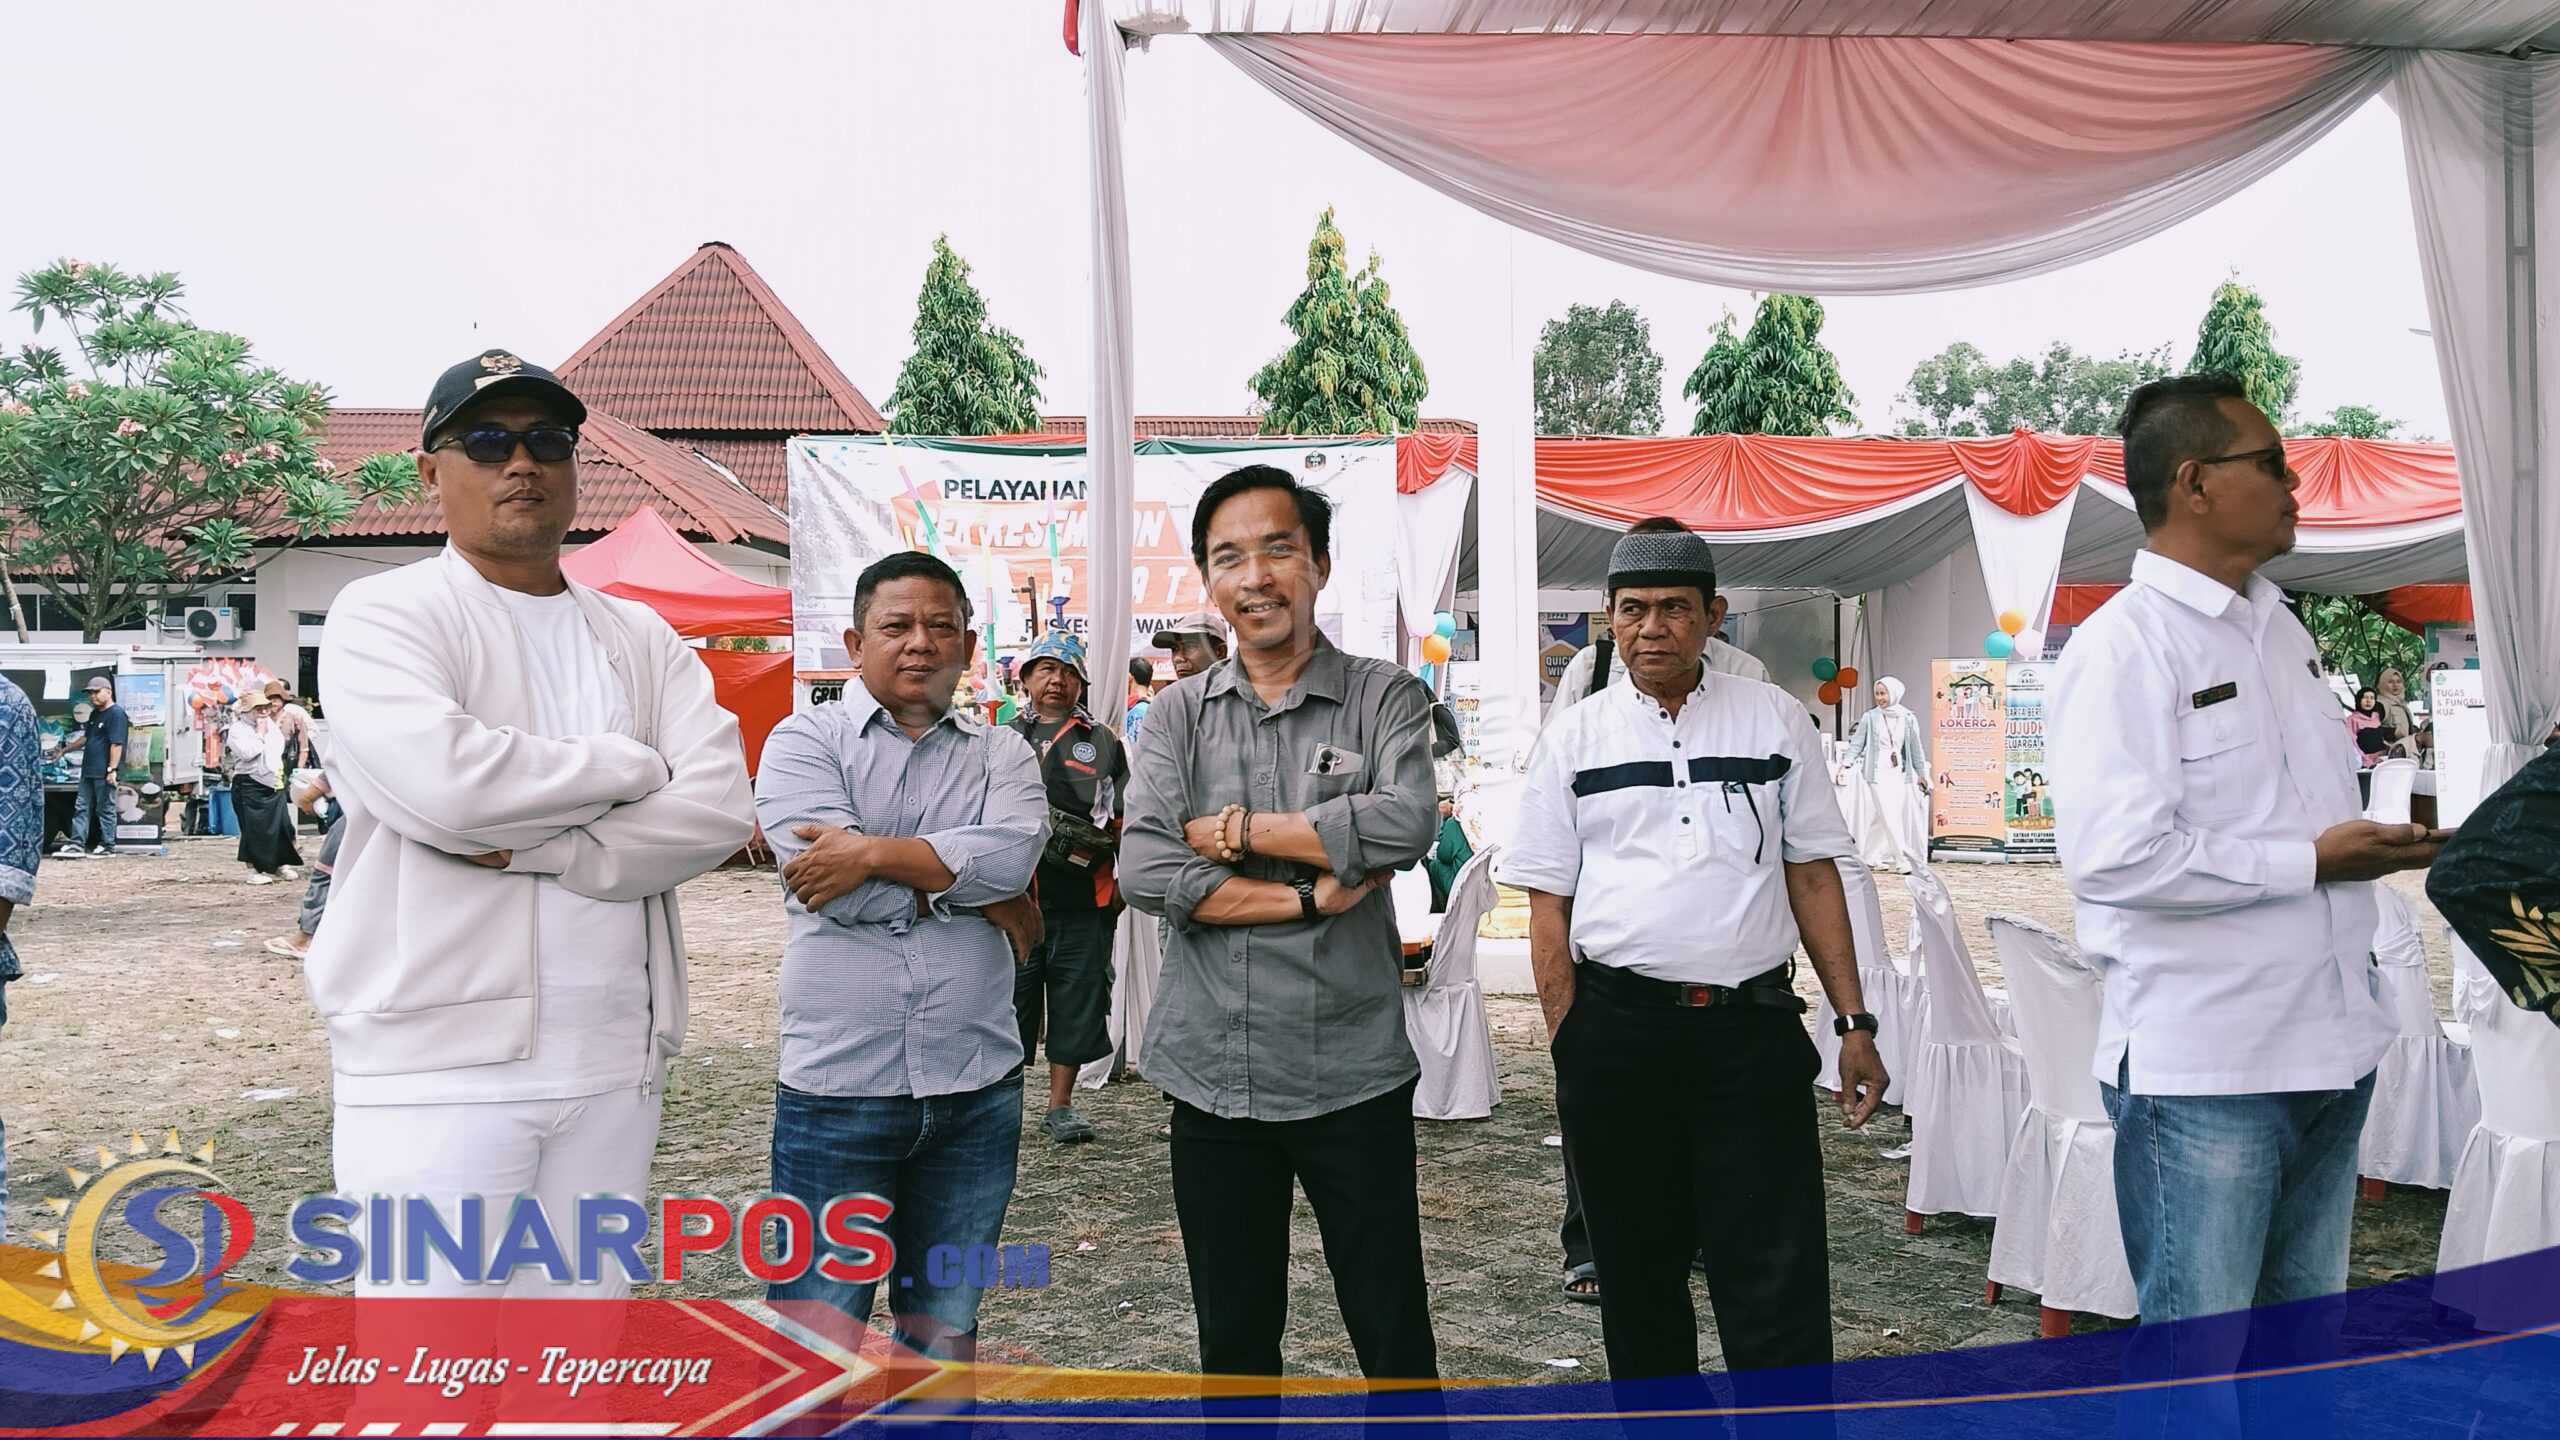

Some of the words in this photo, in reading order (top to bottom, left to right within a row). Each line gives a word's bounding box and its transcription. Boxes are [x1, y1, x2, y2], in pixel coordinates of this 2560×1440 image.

[810, 686, 843, 706] GRAT
[1939, 719, 1997, 728] LOKERGA
[2004, 739, 2038, 749] ELUARGA
